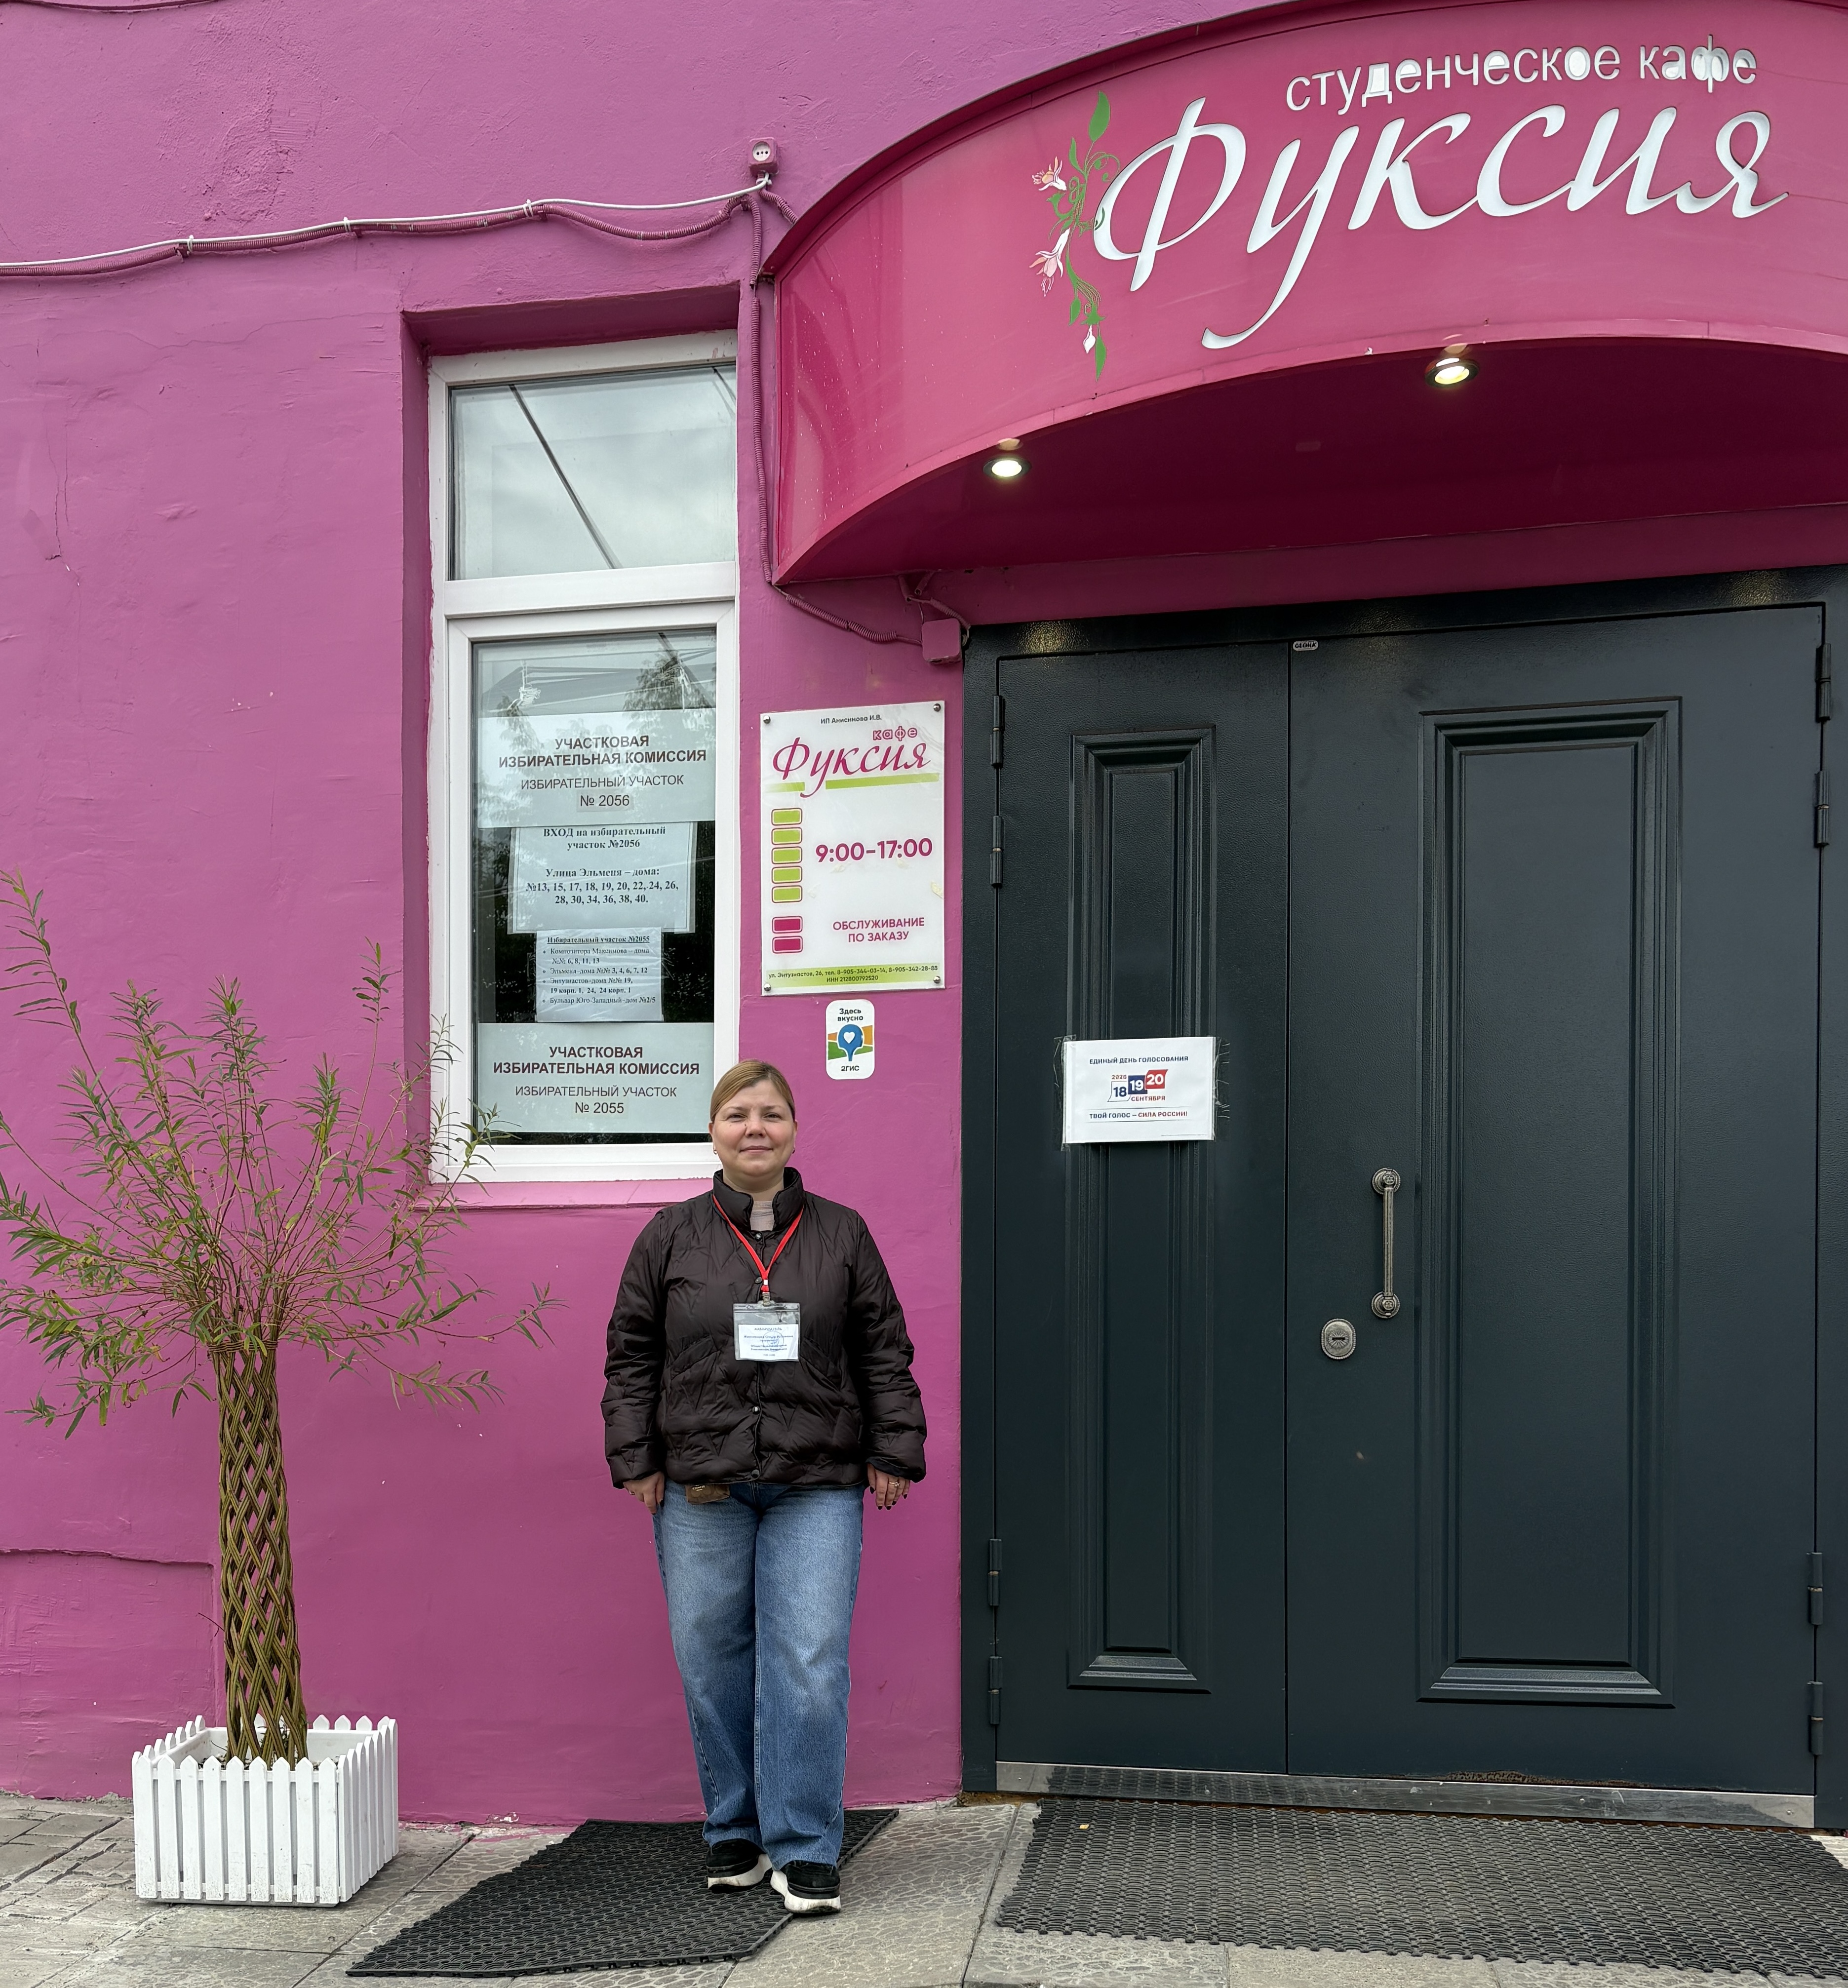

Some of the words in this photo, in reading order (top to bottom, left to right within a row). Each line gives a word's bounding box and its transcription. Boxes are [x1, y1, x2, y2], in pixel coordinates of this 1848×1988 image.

[1285, 44, 1621, 115] студенческое
[1639, 35, 1757, 93] кафе
[1093, 97, 1790, 349] Фуксия
[873, 726, 918, 741] кафе
[554, 735, 650, 750] УЧАСТКОВАЯ
[499, 753, 620, 768] ИЗБИРАТЕЛЬНАЯ
[626, 749, 707, 764] КОМИССИЯ
[773, 737, 931, 798] Фуксия
[521, 775, 626, 790] ИЗБИРАТЕЛЬНЫЙ
[629, 775, 684, 787] УЧАСТОК
[580, 795, 594, 807] №
[599, 794, 629, 807] 2056
[543, 828, 573, 838] ВХОД
[590, 826, 666, 836] избирательный
[567, 842, 605, 851] участок
[608, 839, 640, 848] №2056
[546, 869, 577, 877] Улица
[580, 868, 622, 877] Эльменя
[632, 868, 659, 876] дома:
[526, 883, 550, 893] №13,
[553, 883, 566, 892] 15,
[569, 882, 582, 892] 17,
[586, 882, 598, 892] 18,
[601, 882, 614, 892] 19,
[617, 882, 630, 892] 20,
[633, 882, 646, 891] 22,
[649, 881, 662, 891] 24,
[665, 881, 678, 891] 26,
[555, 896, 568, 905] 28,
[571, 896, 584, 904] 30,
[587, 895, 600, 904] 34,
[603, 895, 616, 904] 36,
[619, 895, 632, 904] 38,
[635, 895, 648, 903] 40.
[833, 917, 925, 931] ОБСЛУЖИВАНИЕ
[848, 933, 864, 942] ПО
[867, 931, 909, 941] ЗАКАЗУ
[549, 1047, 643, 1058] УЧАСТКОВАЯ
[493, 1062, 615, 1074] ИЗБИРАТЕЛЬНАЯ
[619, 1063, 700, 1075] КОМИССИЯ
[515, 1085, 619, 1097] ИЗБИРАТЕЛЬНЫЙ
[623, 1087, 677, 1097] УЧАСТОК
[1113, 1087, 1127, 1097] 18
[1130, 1080, 1144, 1091] 19
[1146, 1074, 1164, 1086] 20
[575, 1102, 590, 1113] №
[593, 1102, 625, 1113] 2055
